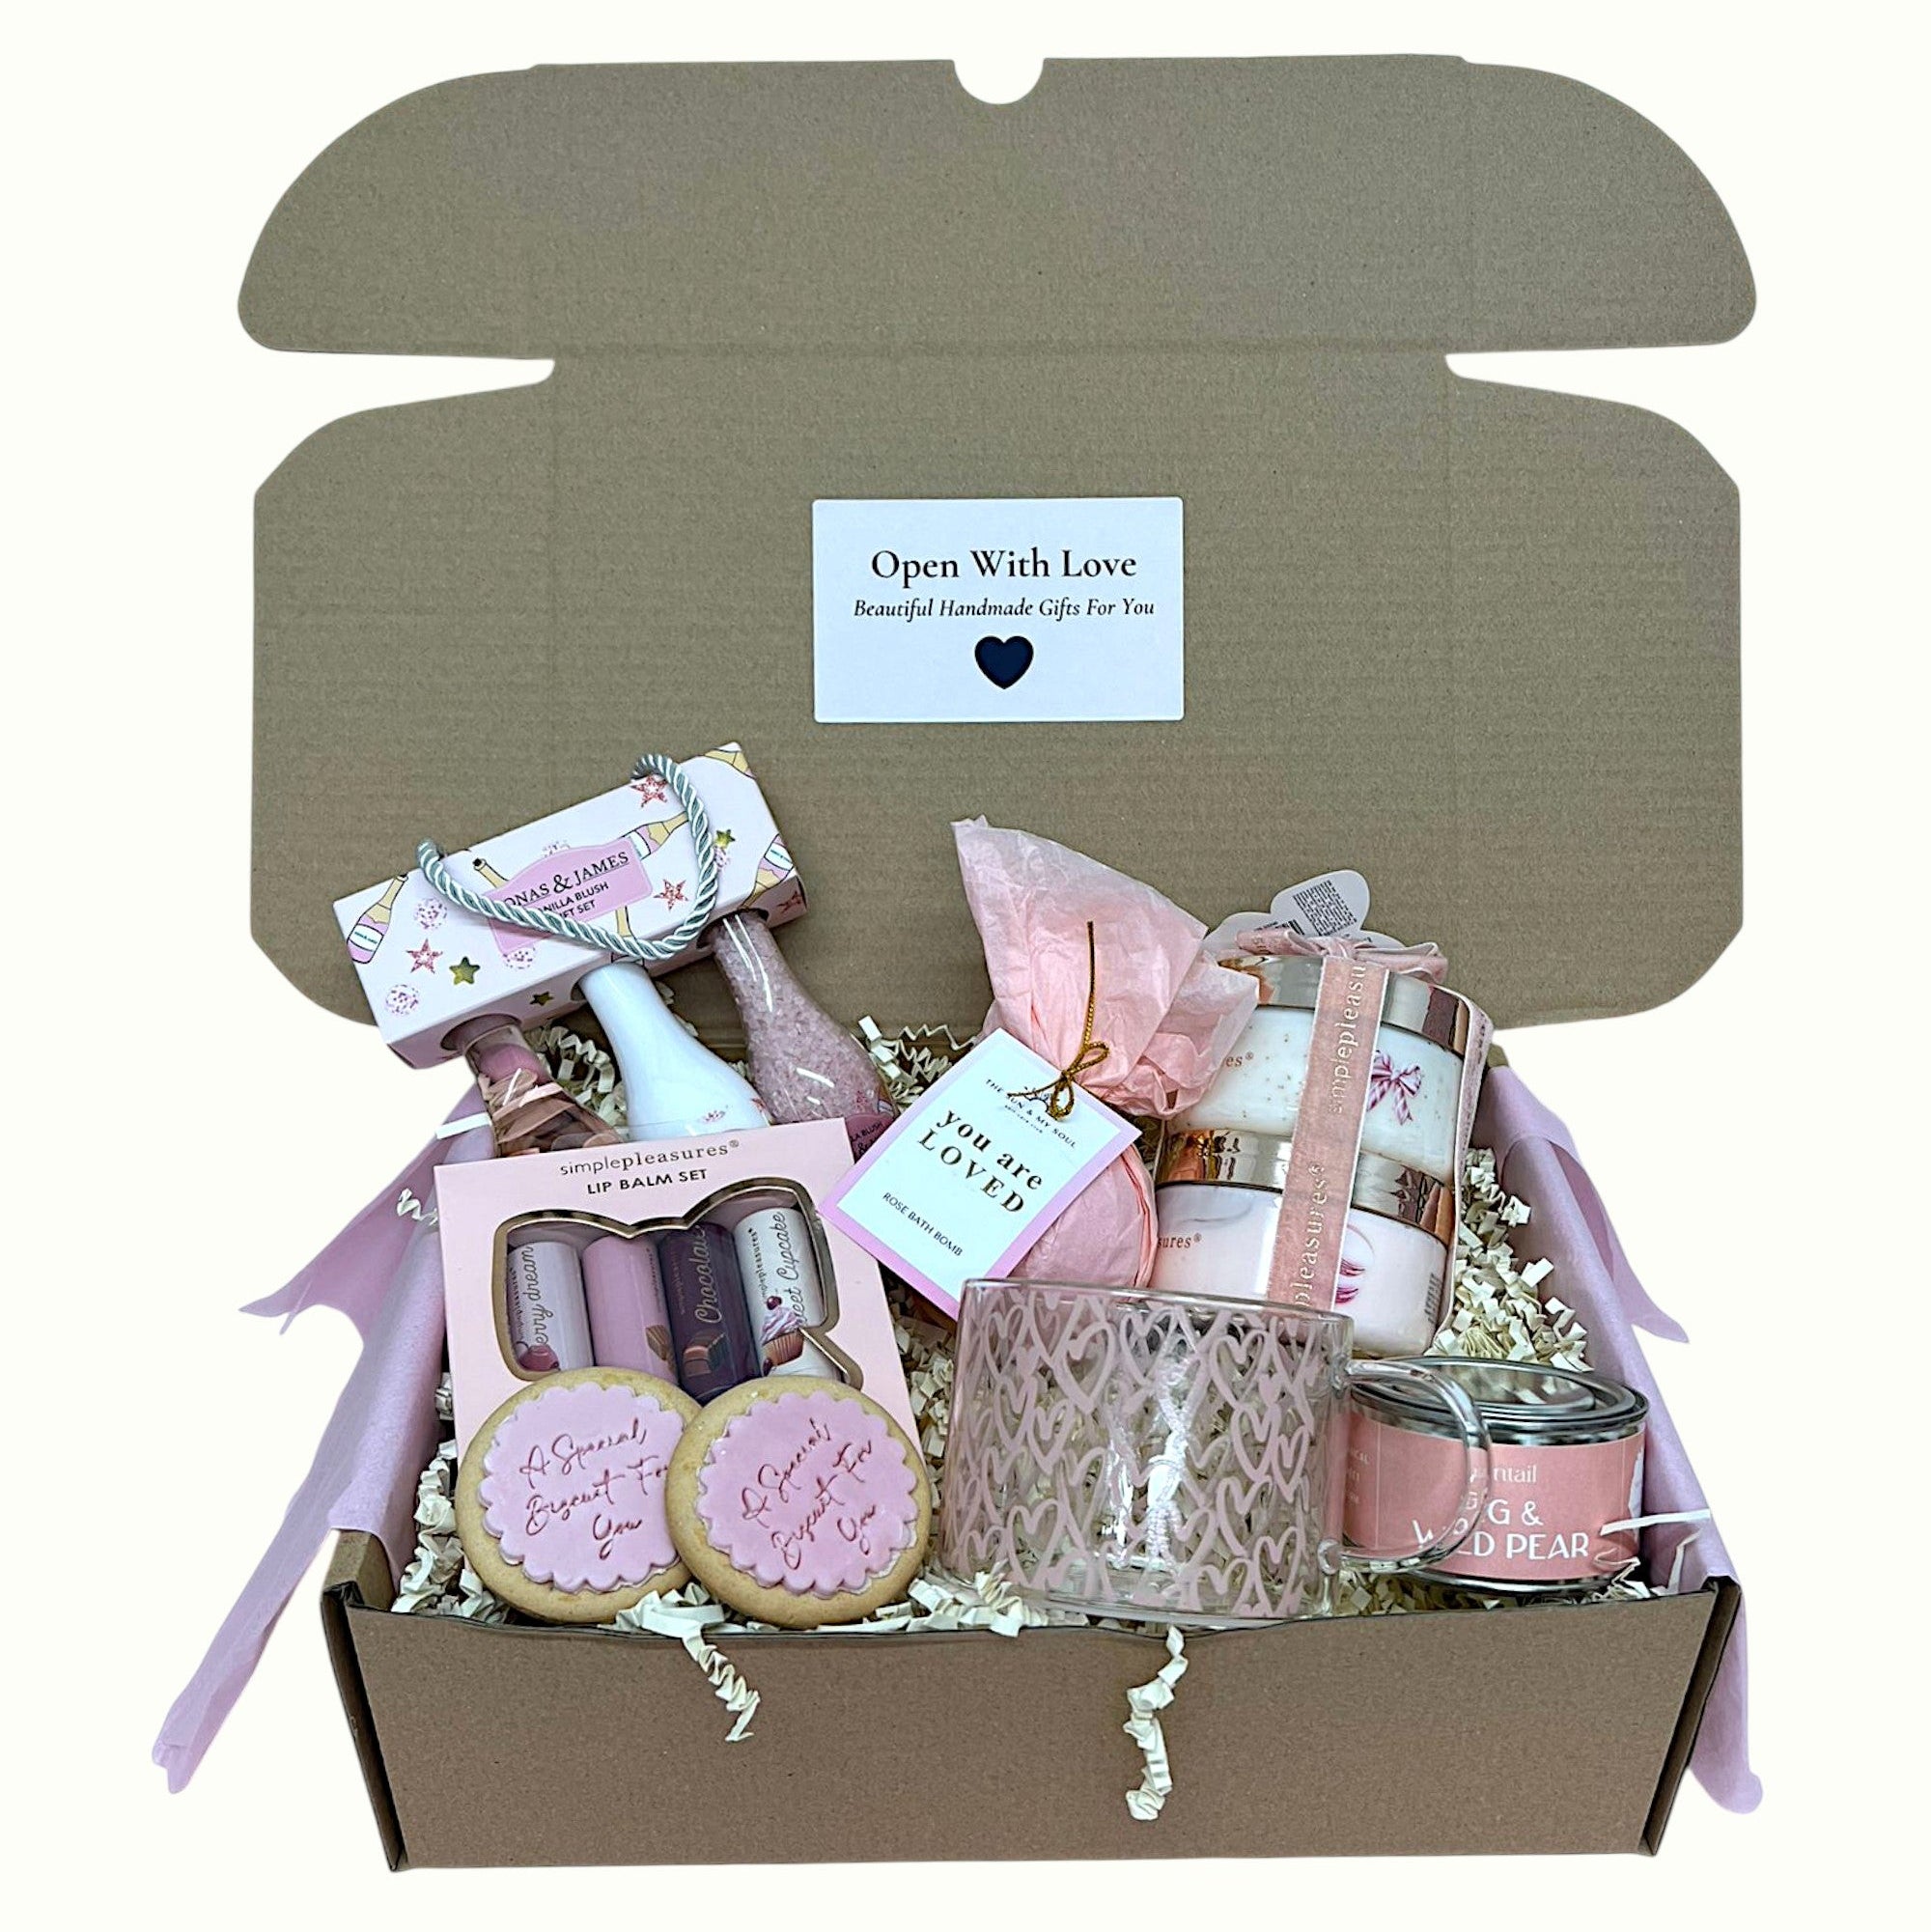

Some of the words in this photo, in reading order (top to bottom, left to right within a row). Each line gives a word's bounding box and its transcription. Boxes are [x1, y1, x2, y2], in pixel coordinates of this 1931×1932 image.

[871, 548, 960, 589] Open
[970, 546, 1050, 578] With
[1061, 548, 1137, 578] Love
[854, 598, 935, 623] Beautiful
[938, 597, 1034, 617] Handmade
[1038, 597, 1080, 622] Gifts
[1086, 597, 1117, 617] For
[1122, 597, 1155, 616] You
[503, 882, 551, 907] ONAS
[553, 874, 574, 894] &
[574, 851, 630, 887] JAMES
[542, 897, 574, 912] NILLA
[574, 881, 610, 901] BLUSH
[576, 899, 597, 914] SET
[986, 1078, 1004, 1093] THE
[1036, 1115, 1051, 1128] MY
[1051, 1128, 1077, 1149] SOUL
[559, 1139, 740, 1175] simplepleasures®
[916, 1128, 1026, 1215] LOVED
[936, 1109, 993, 1154] you
[995, 1151, 1044, 1190] are
[587, 1181, 613, 1195] LIP
[619, 1173, 674, 1191] BALM
[679, 1168, 708, 1183] SET
[769, 1211, 799, 1280] Cupcake
[882, 1190, 910, 1218] ROSE
[908, 1208, 935, 1235] BATH
[933, 1228, 964, 1257] BOMB
[521, 1246, 542, 1302] dream
[518, 1443, 551, 1490] A
[551, 1416, 647, 1476] Special
[627, 1454, 669, 1497] Fo
[742, 1486, 772, 1529] A
[757, 1416, 831, 1504] Special
[832, 1439, 873, 1484] For
[592, 1513, 643, 1561] You
[836, 1503, 878, 1556] You
[1521, 1499, 1545, 1527] &
[1505, 1531, 1590, 1560] PEAR
